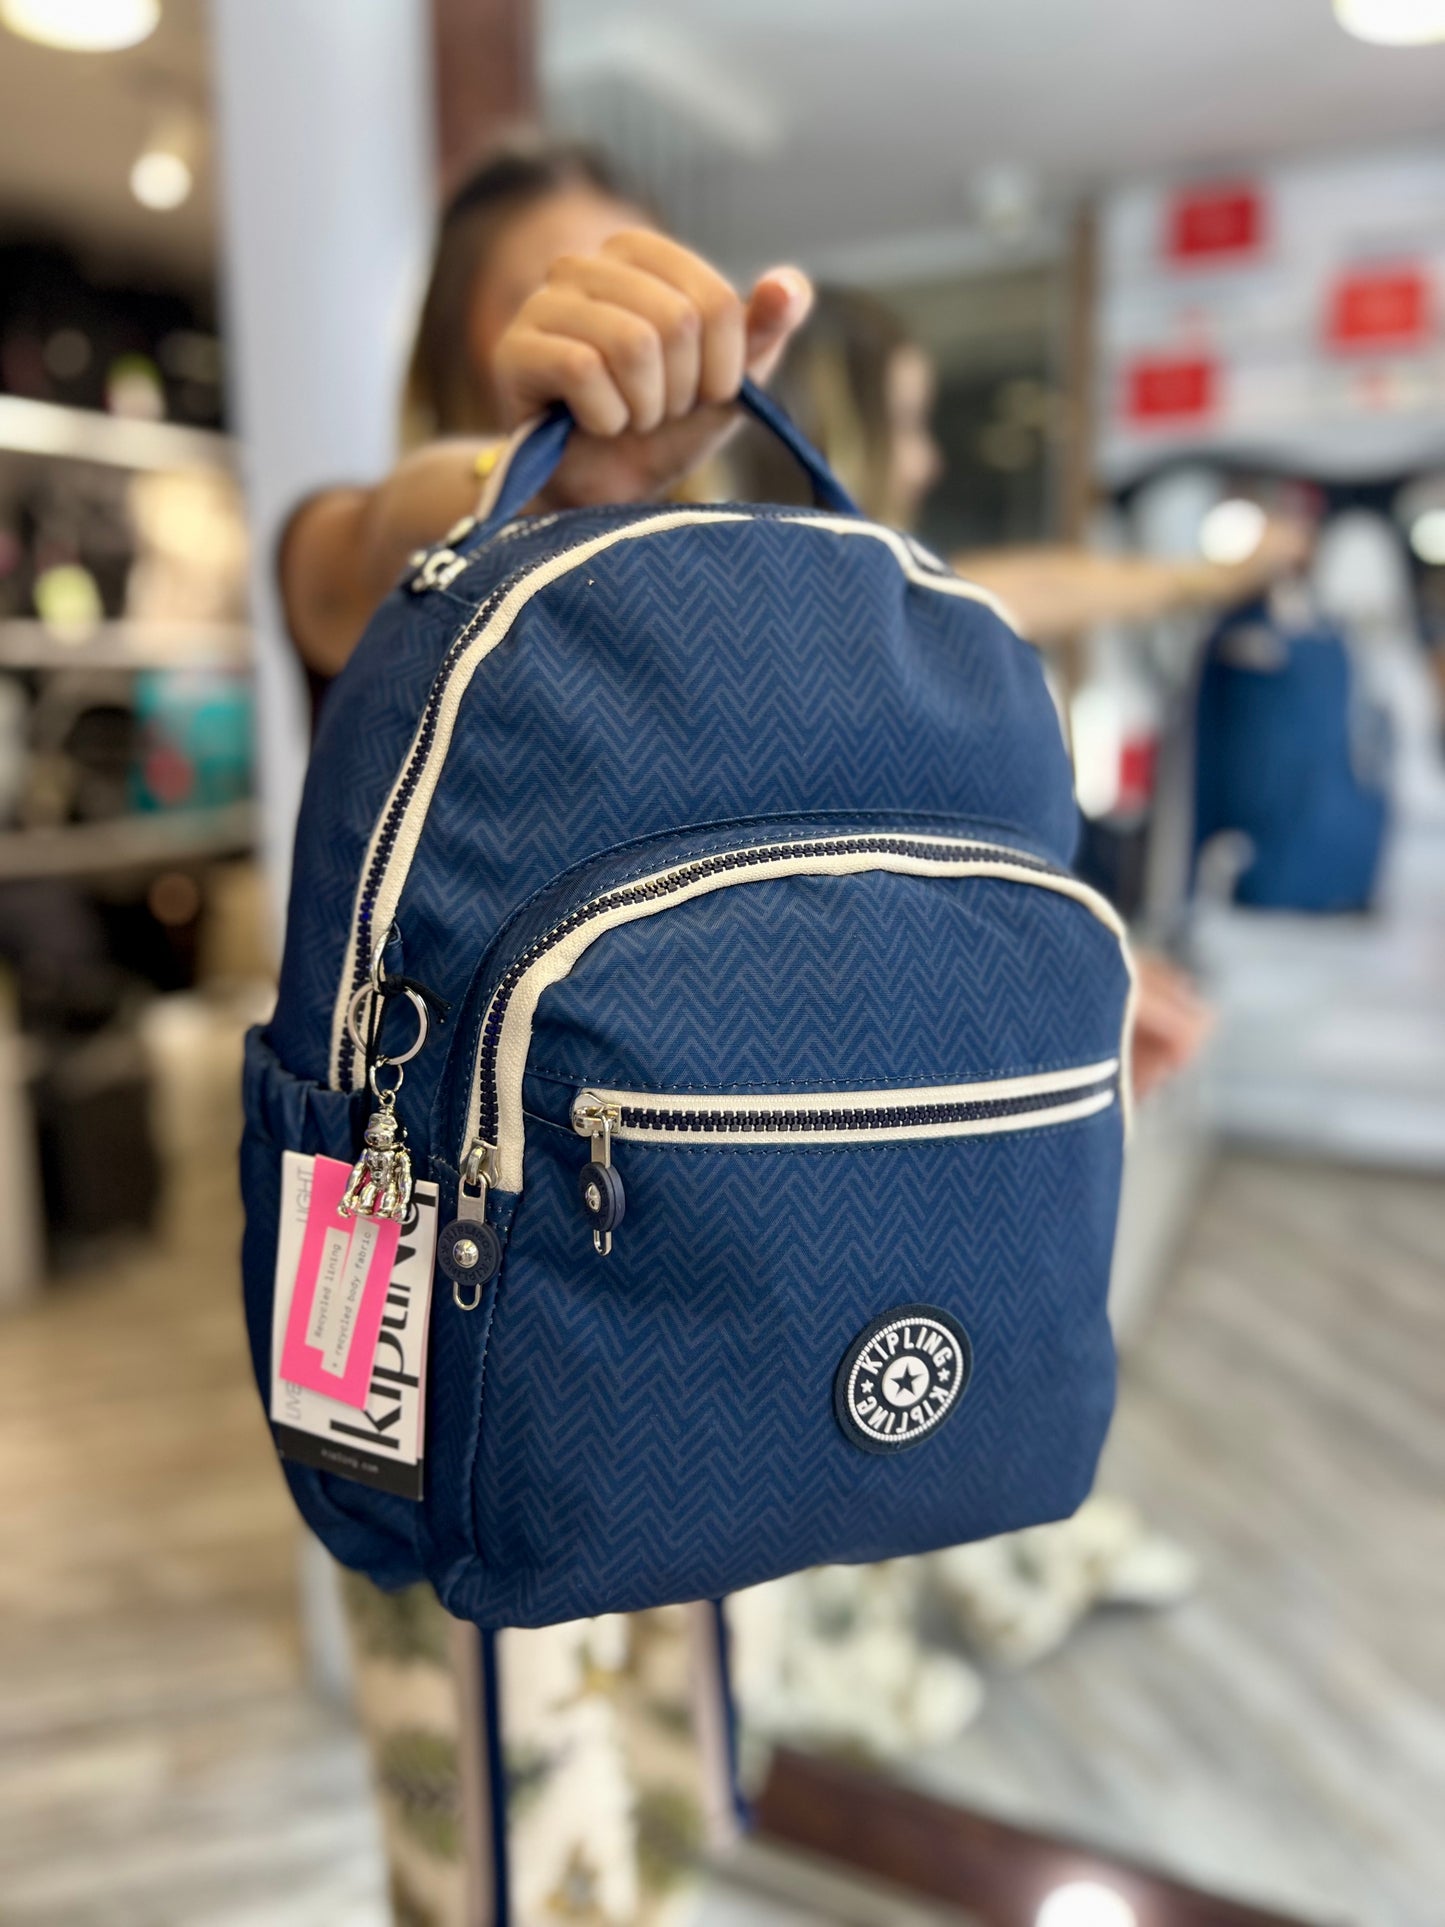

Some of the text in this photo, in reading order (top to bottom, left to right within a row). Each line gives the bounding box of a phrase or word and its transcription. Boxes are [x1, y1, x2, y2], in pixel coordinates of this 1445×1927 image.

[314, 1243, 342, 1338] Recycled lining
[335, 1305, 352, 1356] recycled
[347, 1276, 361, 1302] body
[355, 1231, 372, 1270] fabric
[860, 1326, 953, 1375] KIPLING
[856, 1385, 949, 1434] KIPLING
